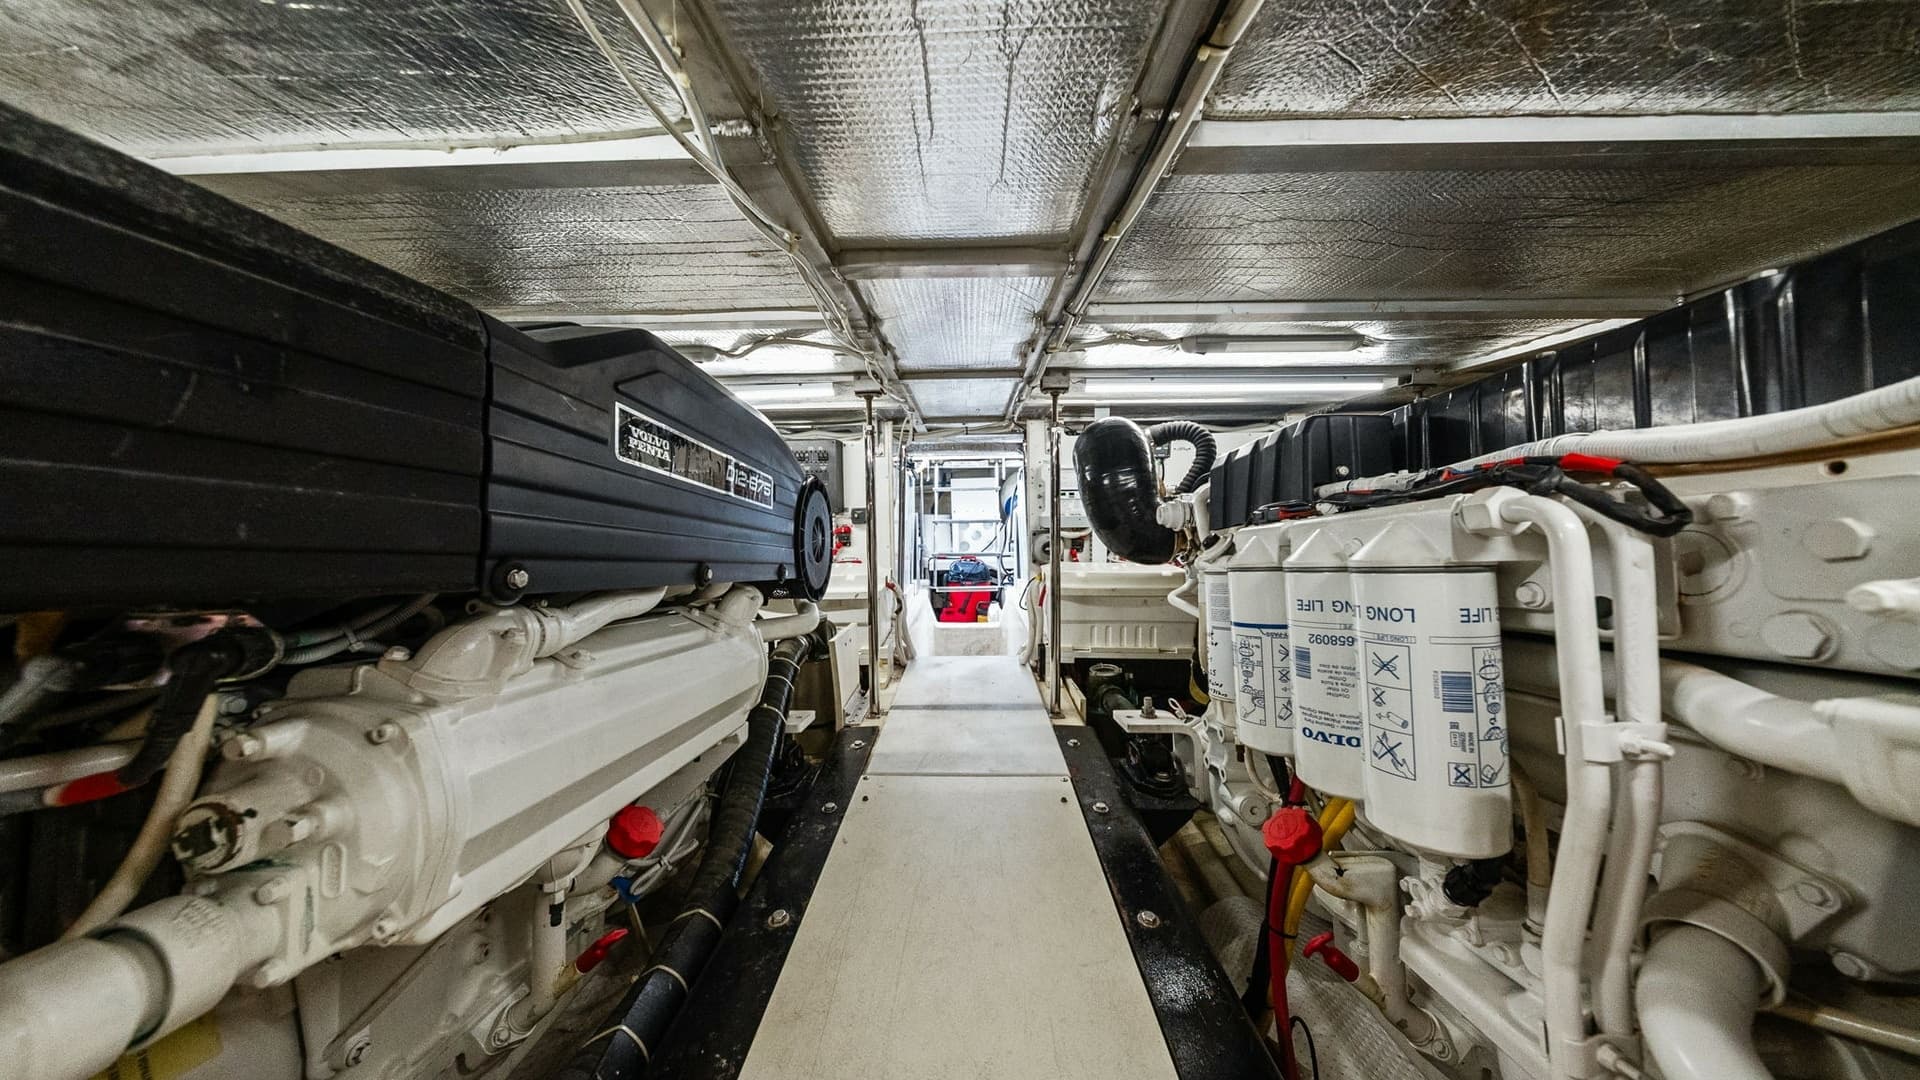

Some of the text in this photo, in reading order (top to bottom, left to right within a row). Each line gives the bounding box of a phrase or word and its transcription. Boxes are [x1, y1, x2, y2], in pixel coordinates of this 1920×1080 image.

[628, 425, 669, 449] VOLVO
[628, 436, 671, 461] PENTA
[1296, 599, 1324, 612] LIFE
[1331, 600, 1354, 613] NG
[1366, 606, 1415, 623] LONG
[1459, 607, 1492, 623] LIFE
[1308, 633, 1355, 647] 658092
[1302, 726, 1361, 748] OLVO
